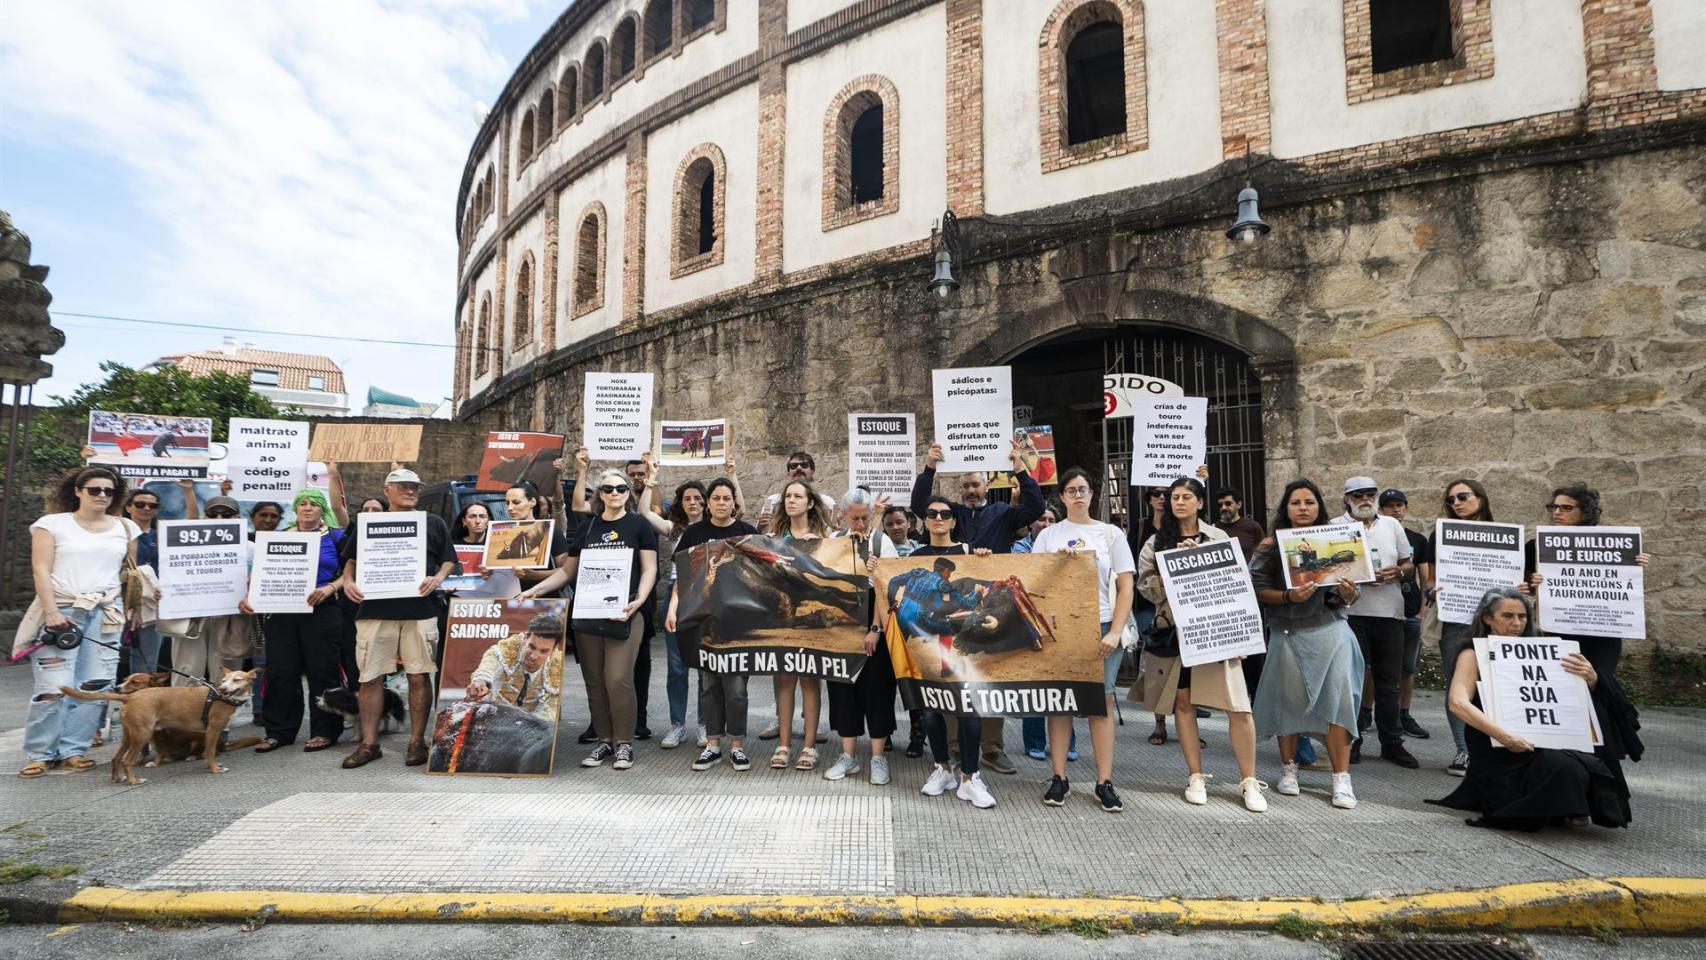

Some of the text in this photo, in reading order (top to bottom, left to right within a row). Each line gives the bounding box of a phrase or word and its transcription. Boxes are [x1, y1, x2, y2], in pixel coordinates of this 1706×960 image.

[947, 388, 997, 397] psicópatas:
[240, 427, 298, 436] maltrato
[861, 421, 901, 432] ESTOQUE
[947, 422, 980, 430] persoas
[246, 440, 291, 449] animal
[950, 443, 998, 451] sufrimento
[244, 467, 290, 478] código
[243, 483, 291, 491] penal!!!
[368, 526, 415, 534] BANDERILLAS
[179, 529, 234, 544] 99,7 %
[1445, 529, 1515, 544] BANDERILLAS
[1545, 536, 1633, 549] 500 MILLONS
[270, 545, 303, 553] ESTOQUE
[1167, 548, 1234, 572] DESCABELO
[1556, 550, 1622, 563] DE EUROS
[1222, 567, 1243, 576] ESPADA
[1561, 568, 1618, 578] AO ANO EN
[1196, 586, 1212, 595] FAENA
[1213, 580, 1246, 592] COMPLICADA
[1547, 578, 1633, 590] SUBVENCIÓNS Á
[1210, 592, 1225, 601] VECES
[1549, 589, 1629, 601] TAUROMAQUIA
[453, 603, 502, 618] ESTO ES
[1207, 612, 1226, 621] MORRE
[1240, 614, 1258, 622] ANIMAL
[450, 624, 510, 639] SADISMO
[1198, 630, 1209, 638] QUE
[1190, 636, 1209, 645] CABEZA
[1210, 630, 1243, 642] AUMENTANDO
[1196, 642, 1208, 650] DOR
[1501, 643, 1560, 661] PONTE
[699, 648, 850, 678] PONTE NA SÚA PEL
[1522, 665, 1548, 682] NA
[920, 682, 1078, 713] ISTO É TORTURA
[1519, 682, 1558, 703] SÚA
[1525, 708, 1560, 726] PEL
